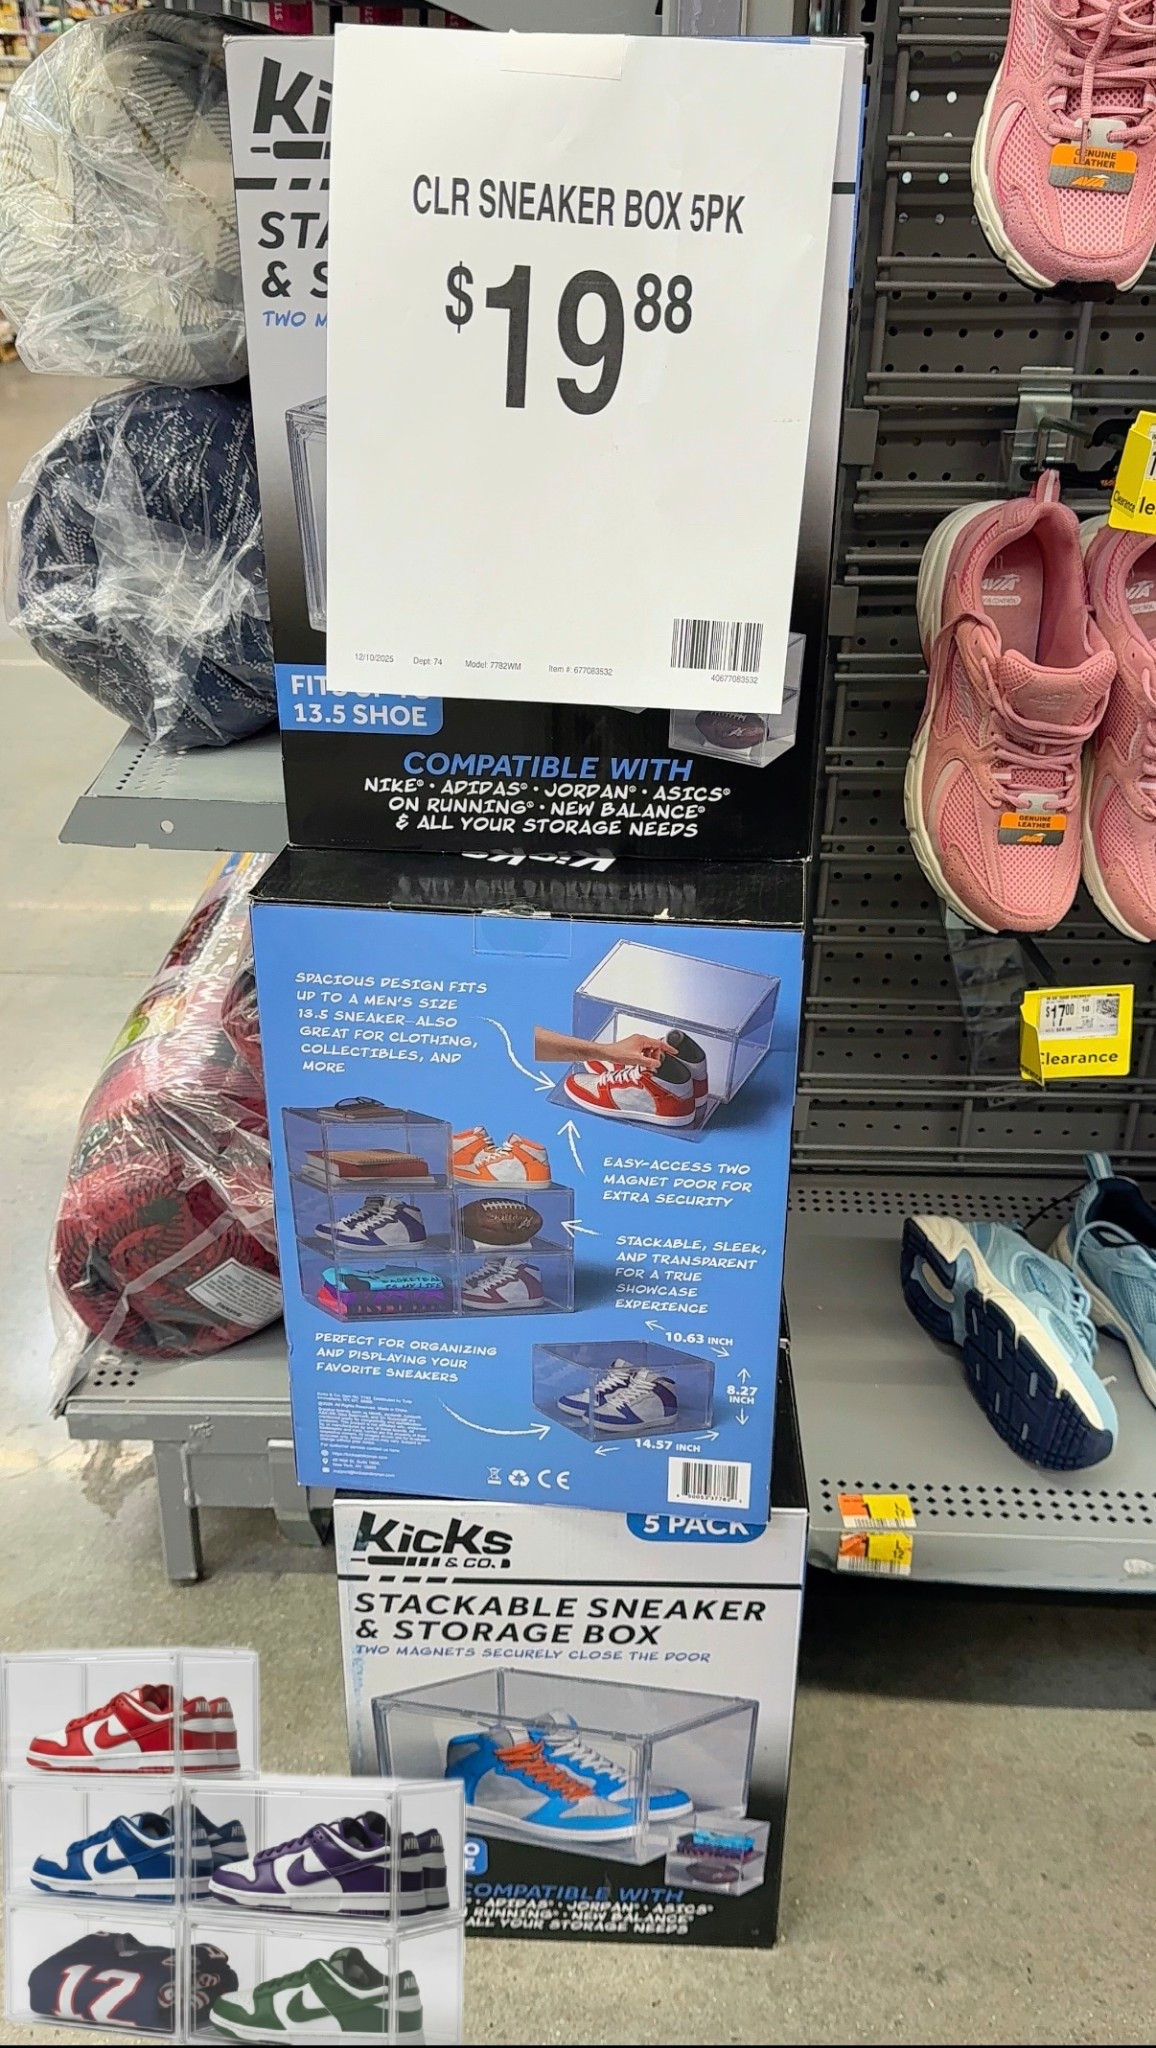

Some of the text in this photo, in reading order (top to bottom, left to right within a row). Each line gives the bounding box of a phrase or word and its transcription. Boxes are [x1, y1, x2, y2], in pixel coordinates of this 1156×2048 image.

[1073, 157, 1116, 169] LATHER
[412, 174, 746, 236] CLR SNEAKER BOX 5PK
[261, 260, 292, 298] &
[262, 310, 307, 328] TWO
[355, 653, 394, 664] 12/10/2025
[413, 656, 443, 667] Dept: 74
[465, 659, 488, 670] Model:
[549, 664, 565, 675] Item
[290, 674, 347, 698] FIT
[293, 703, 428, 727] 13.5 SHOE
[403, 751, 694, 782] COMPATIBLE WITH
[388, 796, 420, 813] ON
[550, 800, 596, 818] NEW
[417, 814, 454, 831] ALL
[460, 816, 516, 834] YOUR
[522, 818, 622, 836] STORAGE
[629, 821, 699, 839] NEEDS
[1017, 821, 1051, 829] LEATHER
[1018, 814, 1052, 822] GENUINE
[295, 972, 488, 994] SPACIOUS DESIGN FITS
[296, 990, 458, 1010] UP TO A MEN'S SIZE
[298, 1008, 329, 1020] 13.5
[299, 1025, 478, 1049] GREAT FOR CLOTHING,
[301, 1043, 462, 1065] COLLECTIBLES, AND
[302, 1060, 346, 1074] MORE
[603, 1156, 751, 1175] EASY-ACCESS TWO
[603, 1173, 753, 1193] MAGNET DOOR FOR
[602, 1190, 734, 1208] EXTRA SECURITY
[616, 1235, 767, 1256] STACKABLE, SLEEK,
[616, 1251, 758, 1270] AND TRANSPARENT
[615, 1267, 703, 1282] FOR A TRUE
[615, 1283, 699, 1298] SHOWCASE
[615, 1298, 709, 1314] EXPERIENCE
[315, 1332, 498, 1357] PERFECT FOR ORGANIZING
[665, 1331, 734, 1347] 10.63 INCH
[316, 1347, 468, 1370] AND DISPLAYING YOUR
[316, 1361, 459, 1383] FAVORITE SNEAKERS
[726, 1385, 758, 1397] 8.27
[728, 1395, 755, 1405] INCH
[634, 1438, 701, 1453] 14.57 INCH
[643, 1514, 750, 1537] 5 PACK
[445, 1557, 496, 1569] & CO.
[354, 1591, 768, 1622] STACKABLE SNEAKER
[355, 1618, 663, 1646] & STORAGE BOX
[355, 1644, 712, 1665] TWO MAGNETS SECURELY CLOSE THE DOOR
[619, 1887, 685, 1903] WITH
[466, 1917, 689, 1935] ALL YOUR STORAGE NEEDS
[571, 1911, 608, 1923] NEW
